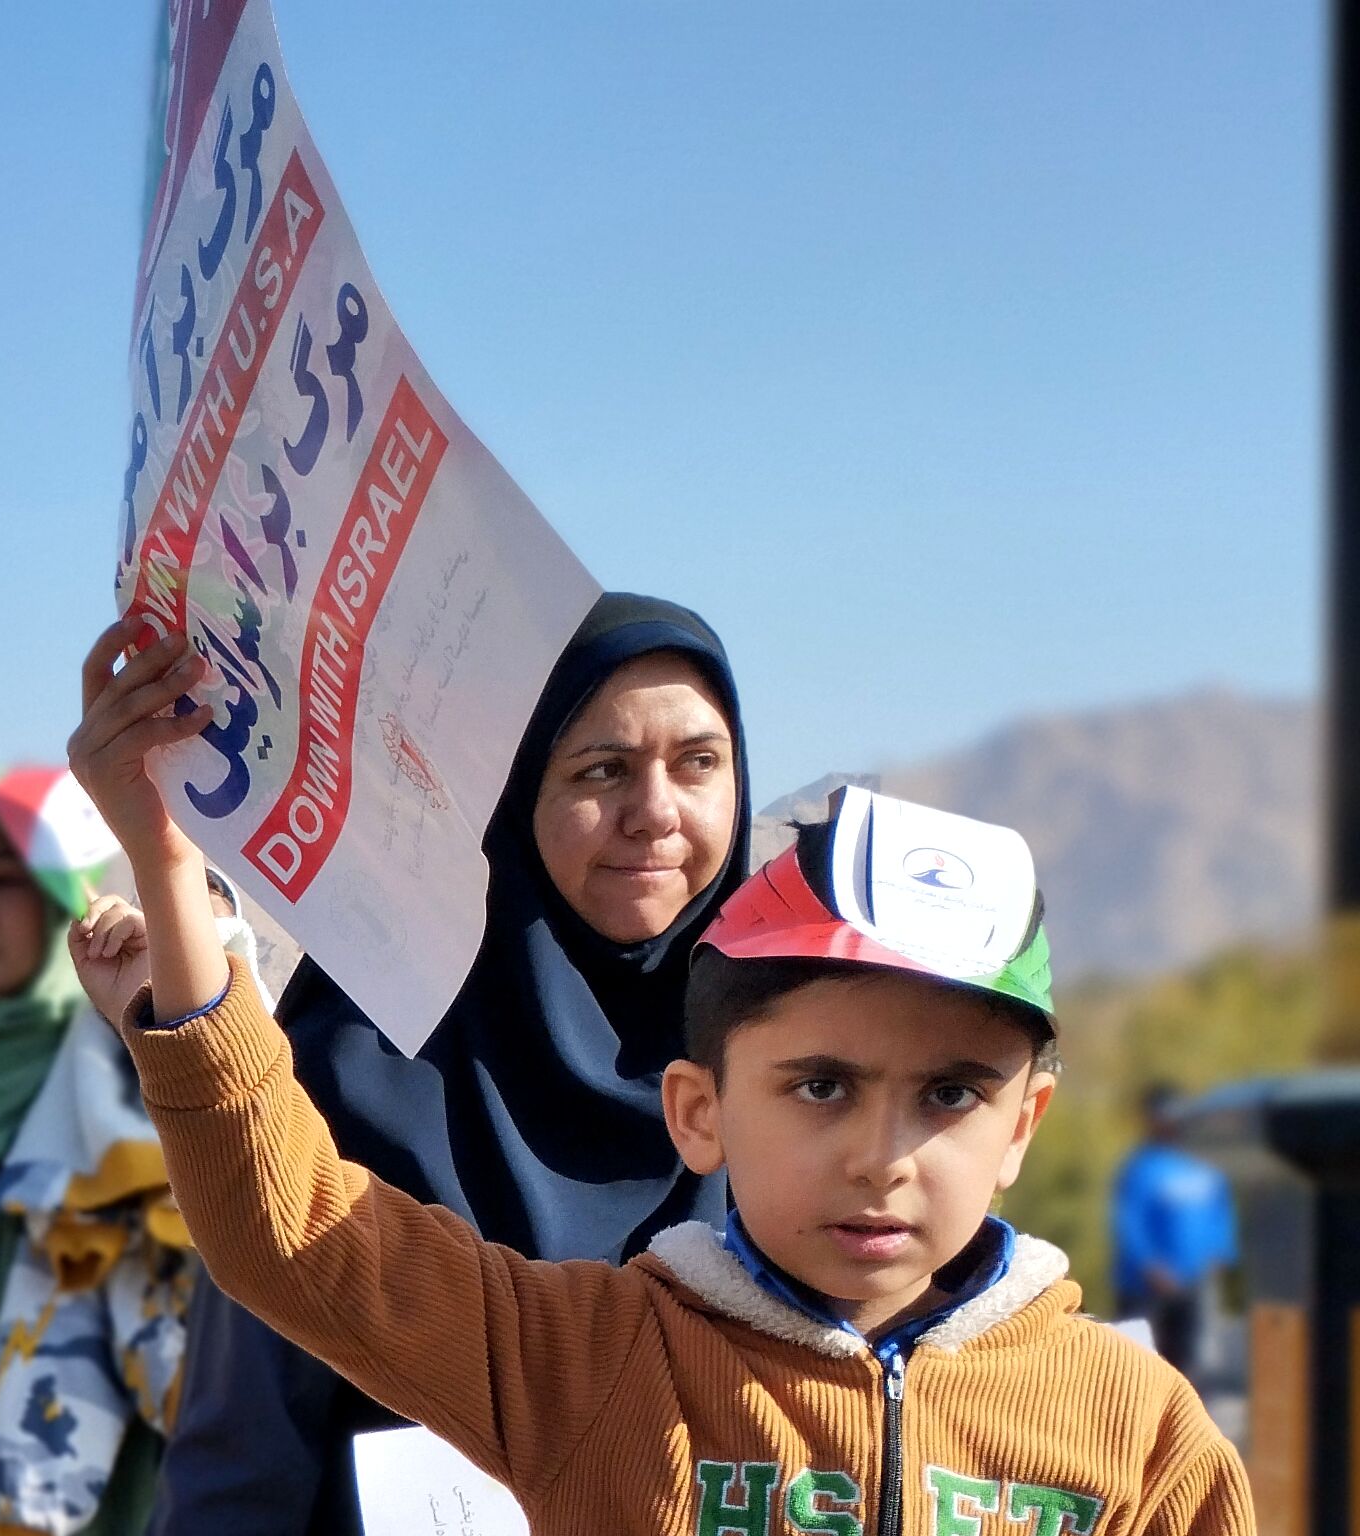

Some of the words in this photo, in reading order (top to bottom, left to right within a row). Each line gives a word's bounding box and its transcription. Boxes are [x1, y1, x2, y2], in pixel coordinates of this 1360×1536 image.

[198, 61, 276, 281] مرگ
[165, 365, 235, 534] WITH
[229, 188, 314, 371] U.S.A
[173, 262, 204, 425] بر
[283, 282, 369, 477] مرگ
[260, 463, 307, 604] بر
[329, 418, 433, 627] ISRAEL
[310, 612, 350, 738] WITH
[257, 727, 340, 885] DOWN
[453, 1486, 475, 1523] بخشی
